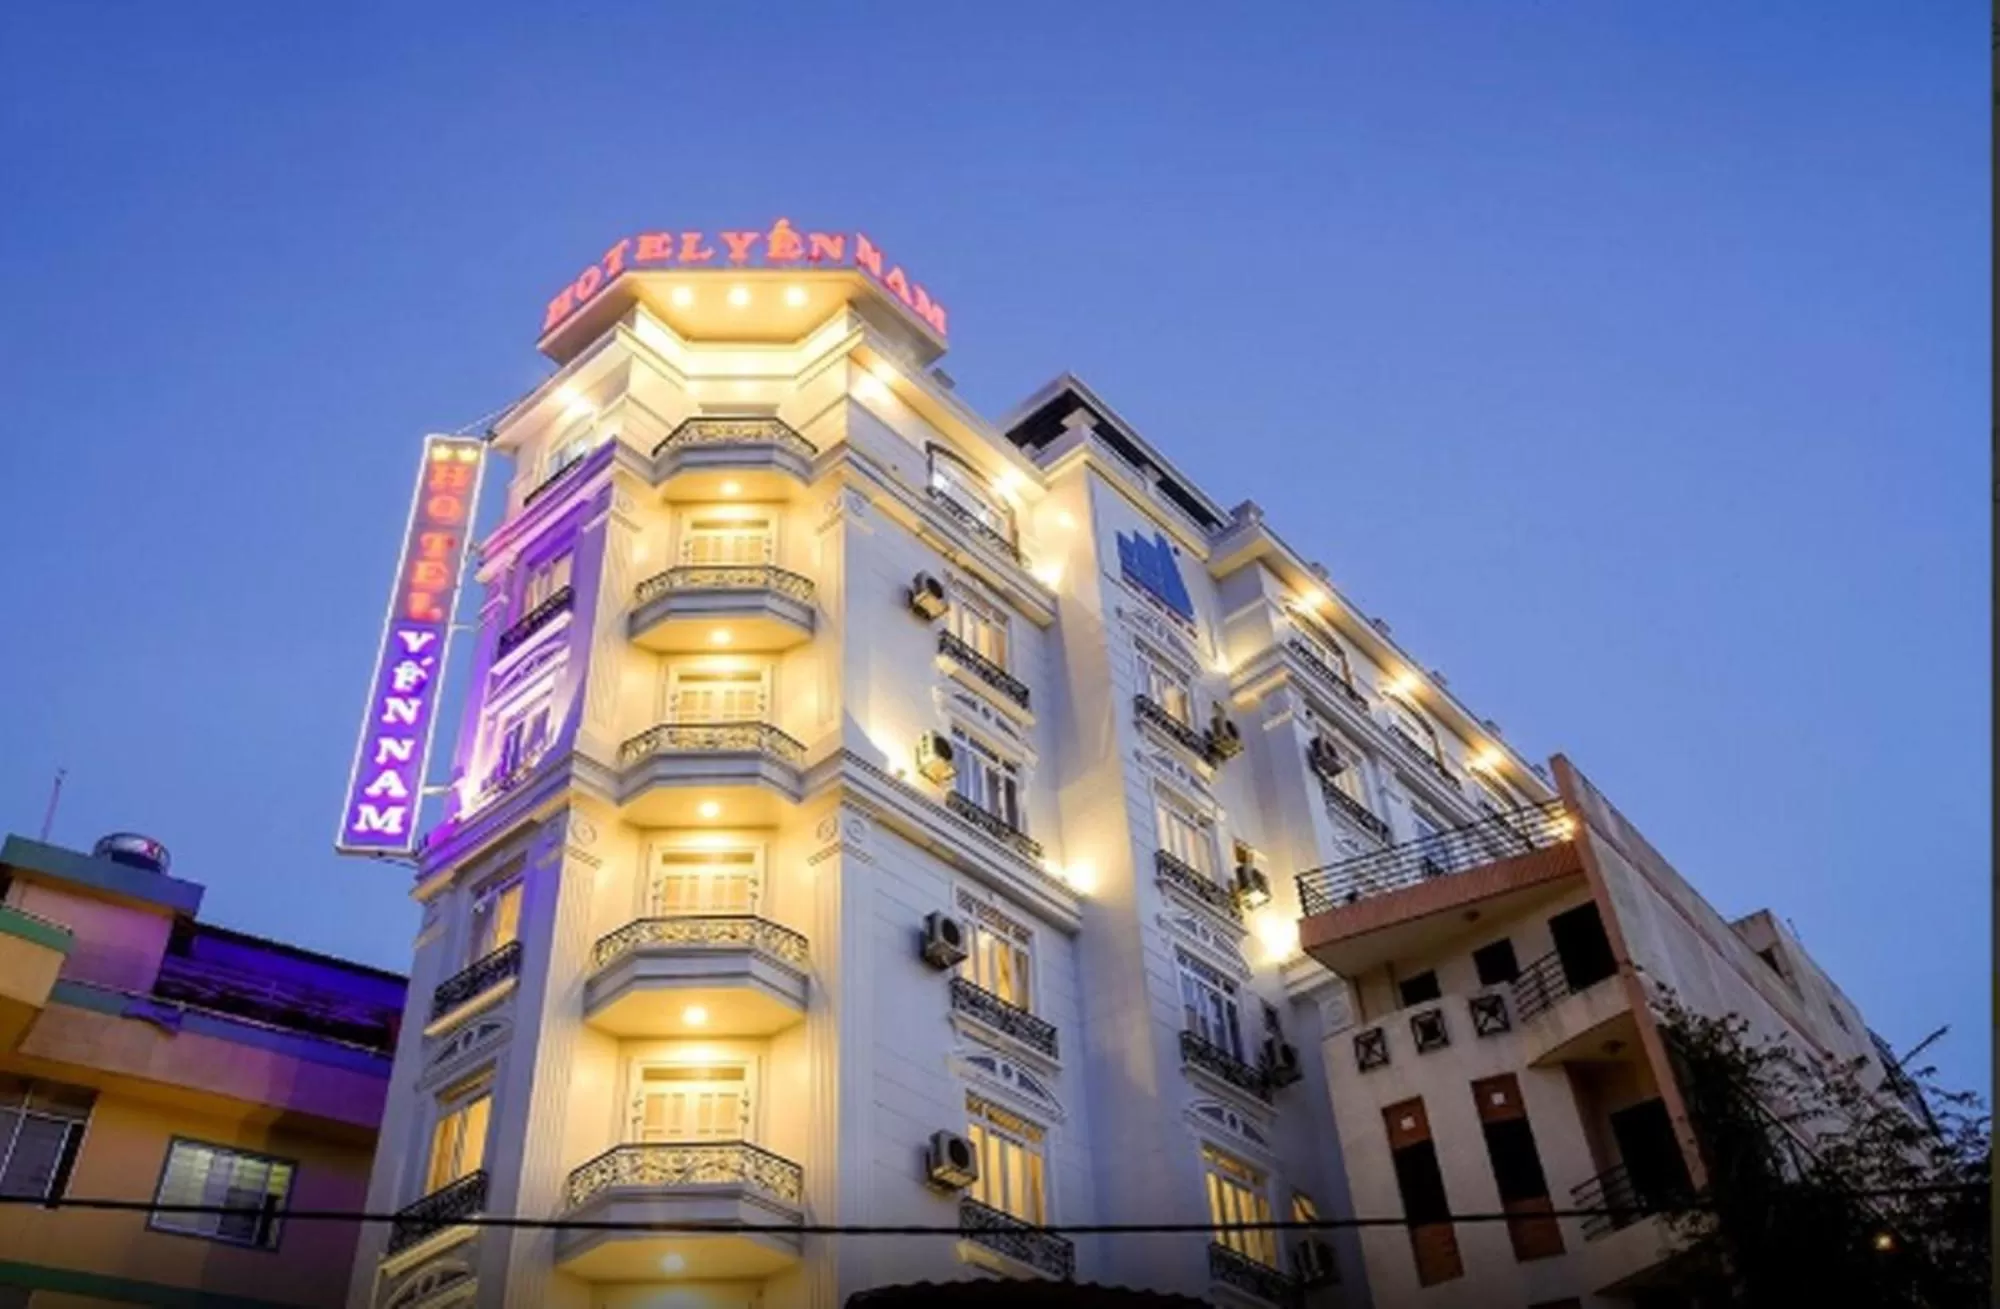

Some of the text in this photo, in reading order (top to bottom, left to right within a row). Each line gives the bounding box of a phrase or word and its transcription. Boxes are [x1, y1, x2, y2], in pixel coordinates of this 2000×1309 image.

[543, 231, 715, 331] HOTEL
[855, 231, 948, 336] NAM
[407, 462, 471, 621] HOTEL
[353, 736, 416, 835] NAM
